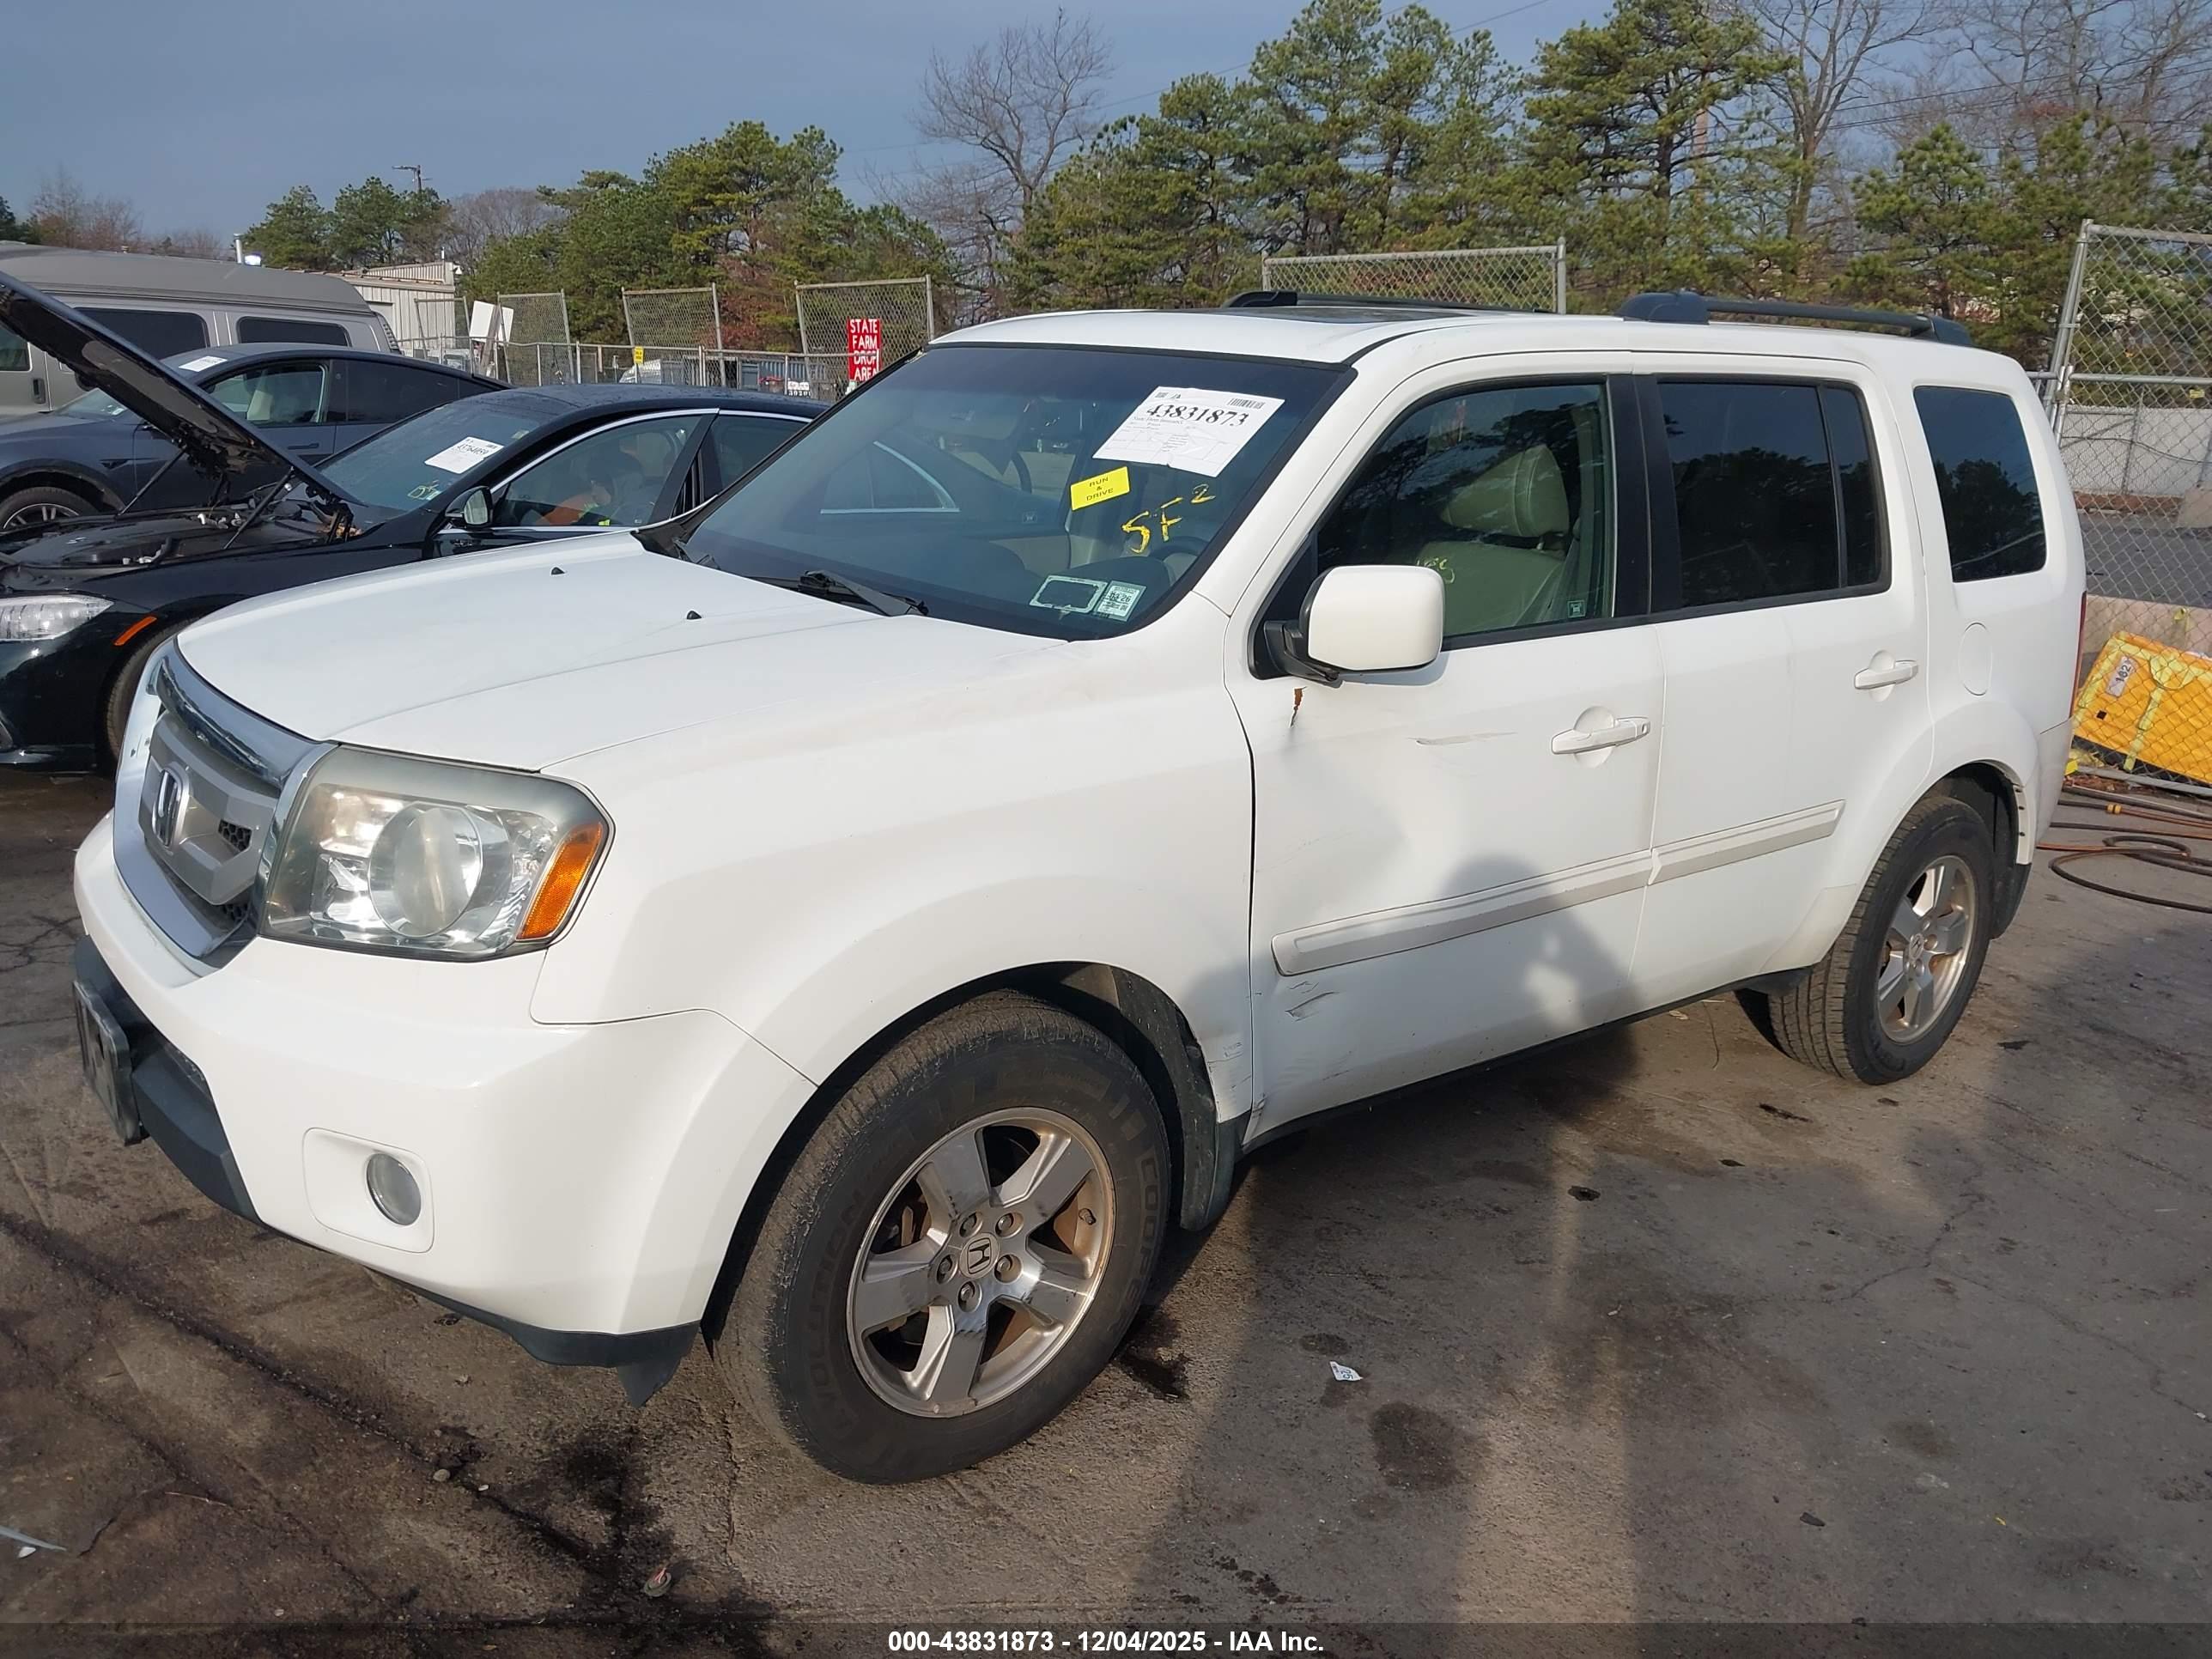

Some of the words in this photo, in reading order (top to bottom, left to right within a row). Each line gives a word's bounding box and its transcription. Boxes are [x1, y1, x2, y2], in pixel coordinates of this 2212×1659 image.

[849, 319, 878, 333] STATE
[852, 335, 878, 349] FARM
[854, 350, 876, 365] DROP
[1147, 404, 1249, 427] 43831873
[1089, 477, 1109, 487] RUN
[1086, 488, 1114, 501] DRIVE
